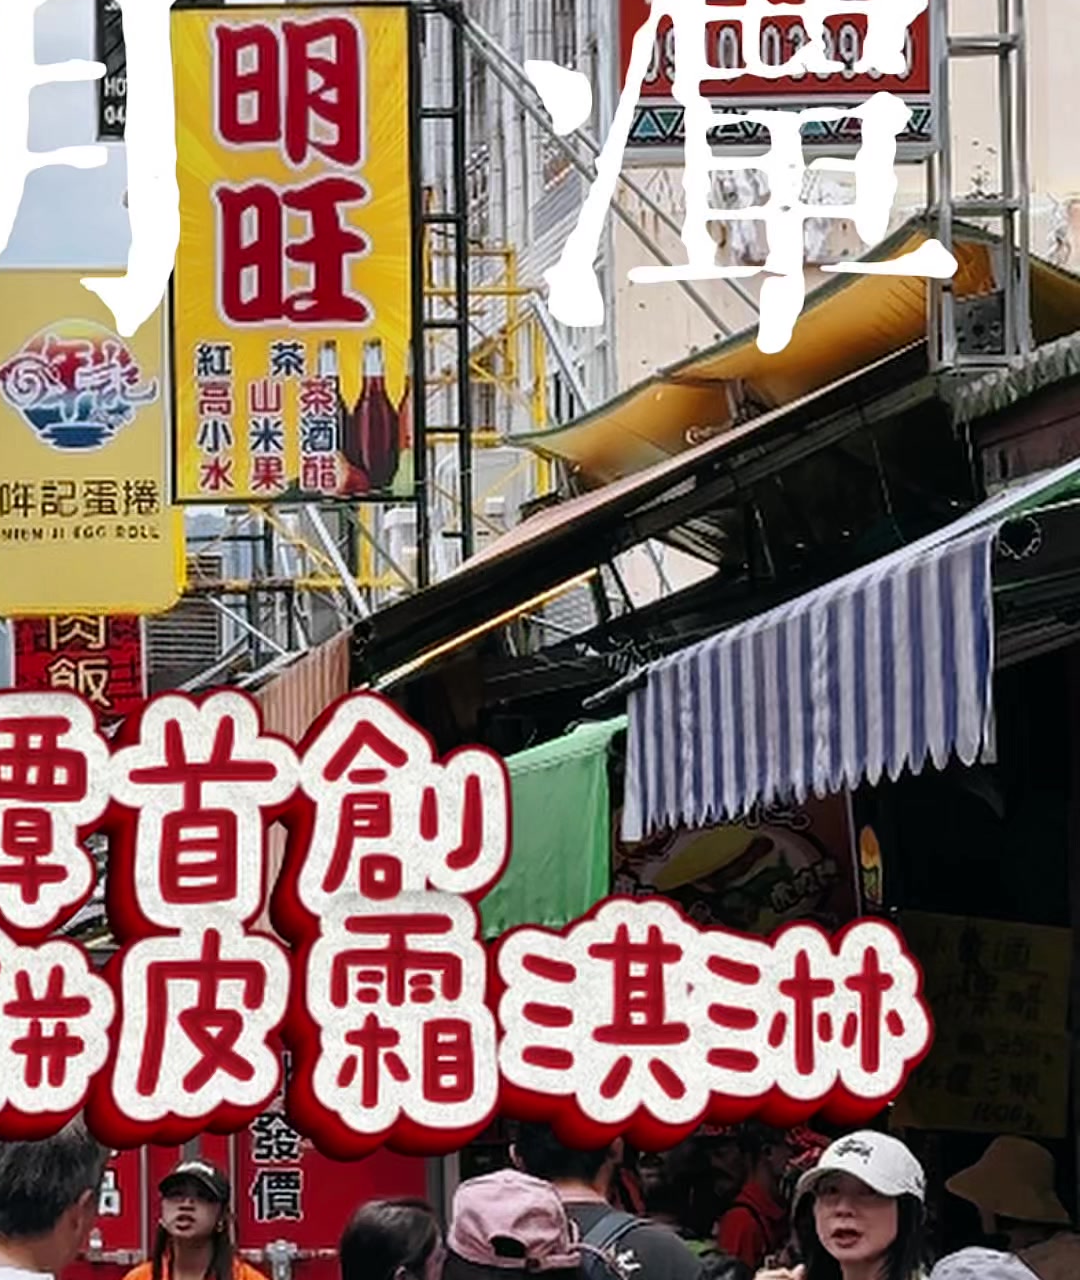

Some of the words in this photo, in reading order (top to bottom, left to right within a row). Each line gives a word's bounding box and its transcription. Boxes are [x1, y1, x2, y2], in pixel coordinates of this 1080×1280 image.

[212, 13, 372, 328] 明旺
[197, 342, 305, 377] 紅茶
[197, 379, 336, 415] 高山茶
[197, 418, 336, 454] 小米酒
[199, 455, 337, 492] 水果醋
[73, 525, 107, 539] EGG
[115, 524, 160, 539] ROLL
[251, 1052, 303, 1222] 發價
